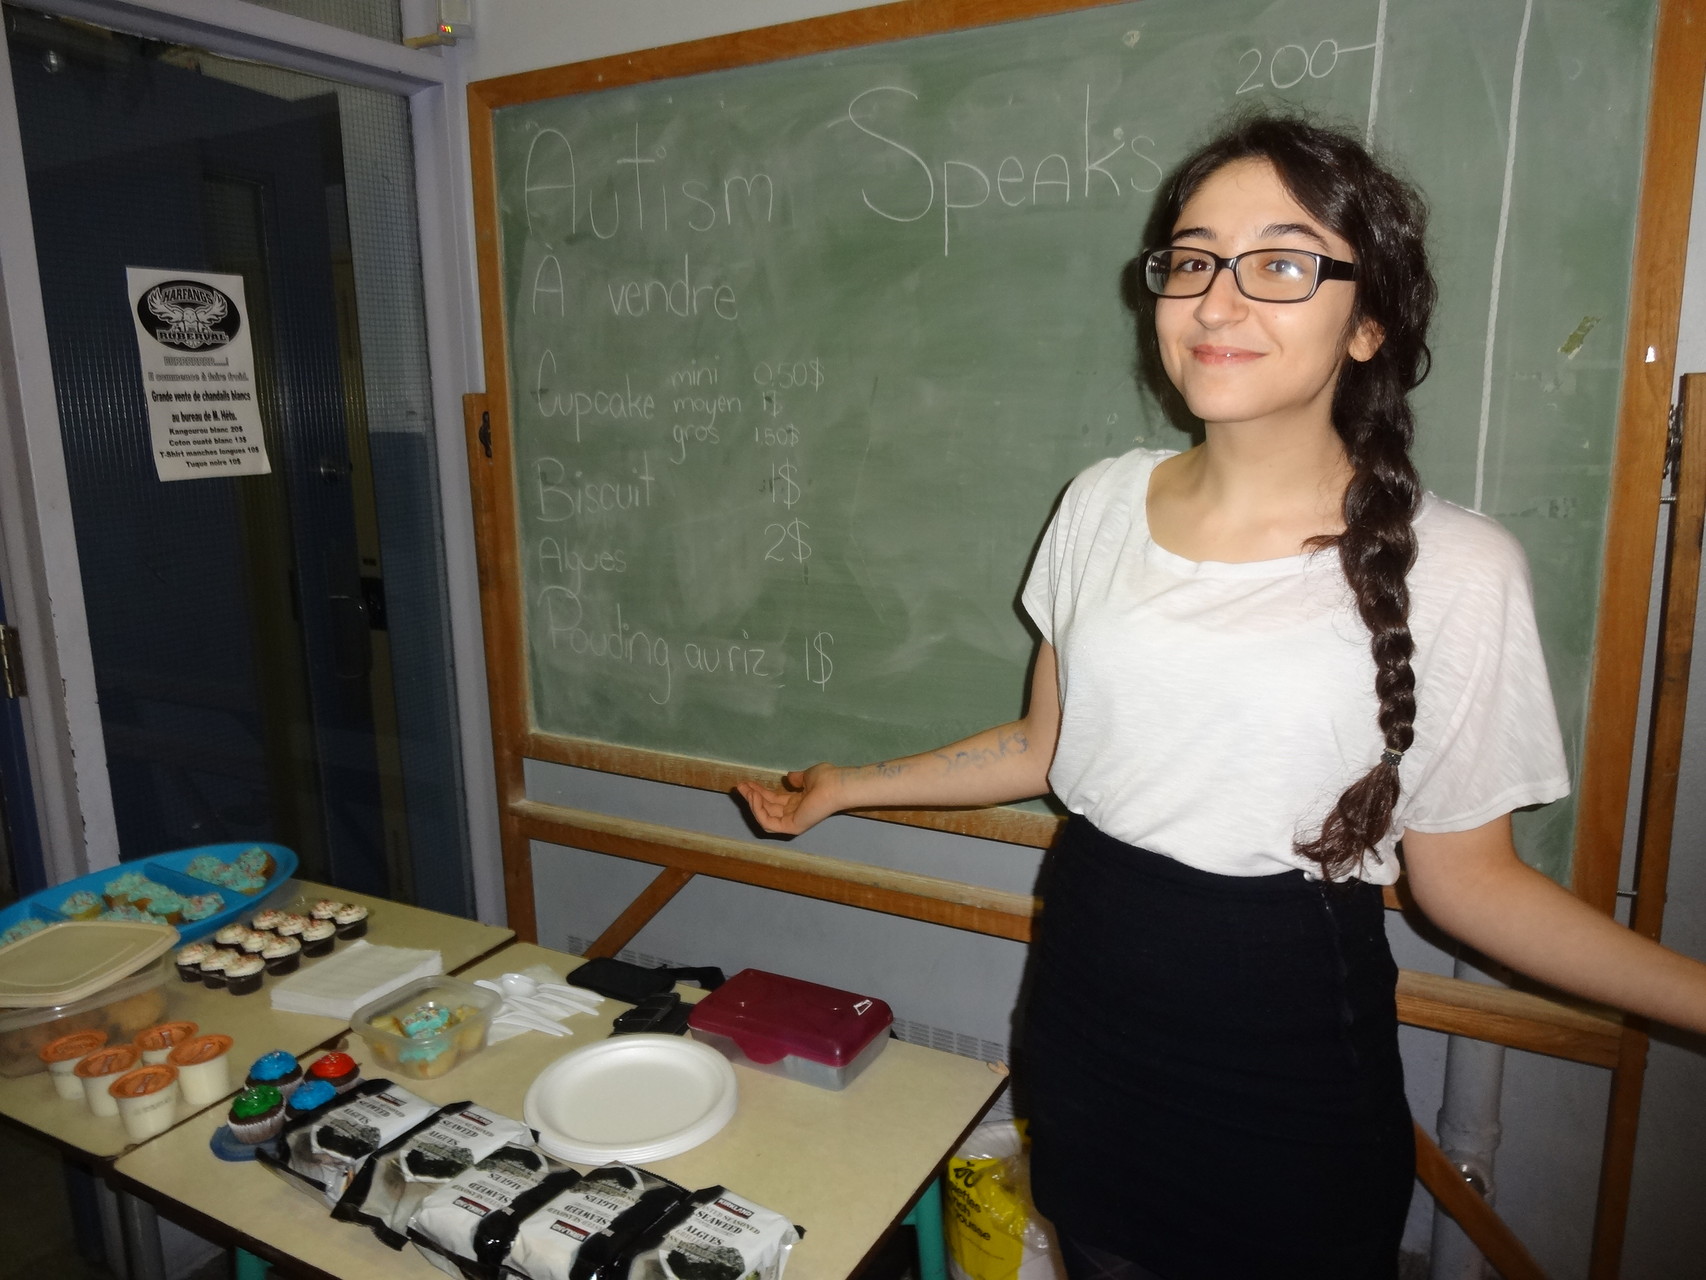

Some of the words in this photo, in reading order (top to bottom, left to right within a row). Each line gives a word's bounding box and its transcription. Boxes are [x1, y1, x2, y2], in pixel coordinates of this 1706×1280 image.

[1236, 38, 1338, 95] 200
[524, 121, 774, 240] Autism
[163, 288, 214, 305] HARFANGS
[607, 252, 738, 320] vendre
[671, 354, 719, 388] mini
[151, 390, 173, 402] Grande
[174, 391, 192, 402] vente
[193, 390, 201, 402] de
[201, 390, 231, 402] chandails
[230, 389, 251, 401] blancs
[537, 349, 655, 443] Cupcake
[672, 394, 742, 429] moyen
[172, 413, 181, 423] au
[180, 411, 203, 422] bureau
[203, 411, 212, 422] de
[212, 410, 221, 421] M.
[168, 427, 209, 436] Kangourou
[209, 426, 229, 434] blanc
[230, 425, 244, 433] 20$
[159, 450, 185, 458] T-Shirt
[185, 449, 218, 457] manches
[218, 447, 247, 456] longues
[168, 439, 191, 447] Coton
[192, 438, 212, 446] ouaté
[214, 437, 233, 445] blanc
[669, 424, 720, 465] gros
[186, 461, 208, 469] Tuque
[533, 450, 655, 522] Biscuit
[771, 457, 801, 510] 1$
[538, 536, 627, 596] Algues
[763, 517, 812, 564] 2$
[537, 585, 672, 705] Pouding
[804, 631, 834, 692] 1$
[429, 1130, 458, 1146] ALGUES
[442, 1120, 479, 1137] SEAWEED
[488, 1172, 521, 1190] ALGUES
[468, 1182, 511, 1203] SEAWEED
[584, 1194, 619, 1211] ALGUES
[564, 1204, 608, 1226] SEAWEED
[718, 1198, 753, 1218] KIRKLAND
[697, 1210, 743, 1235] SEAWEED
[723, 1214, 761, 1235] SEASONED
[684, 1224, 722, 1246] ALGUES
